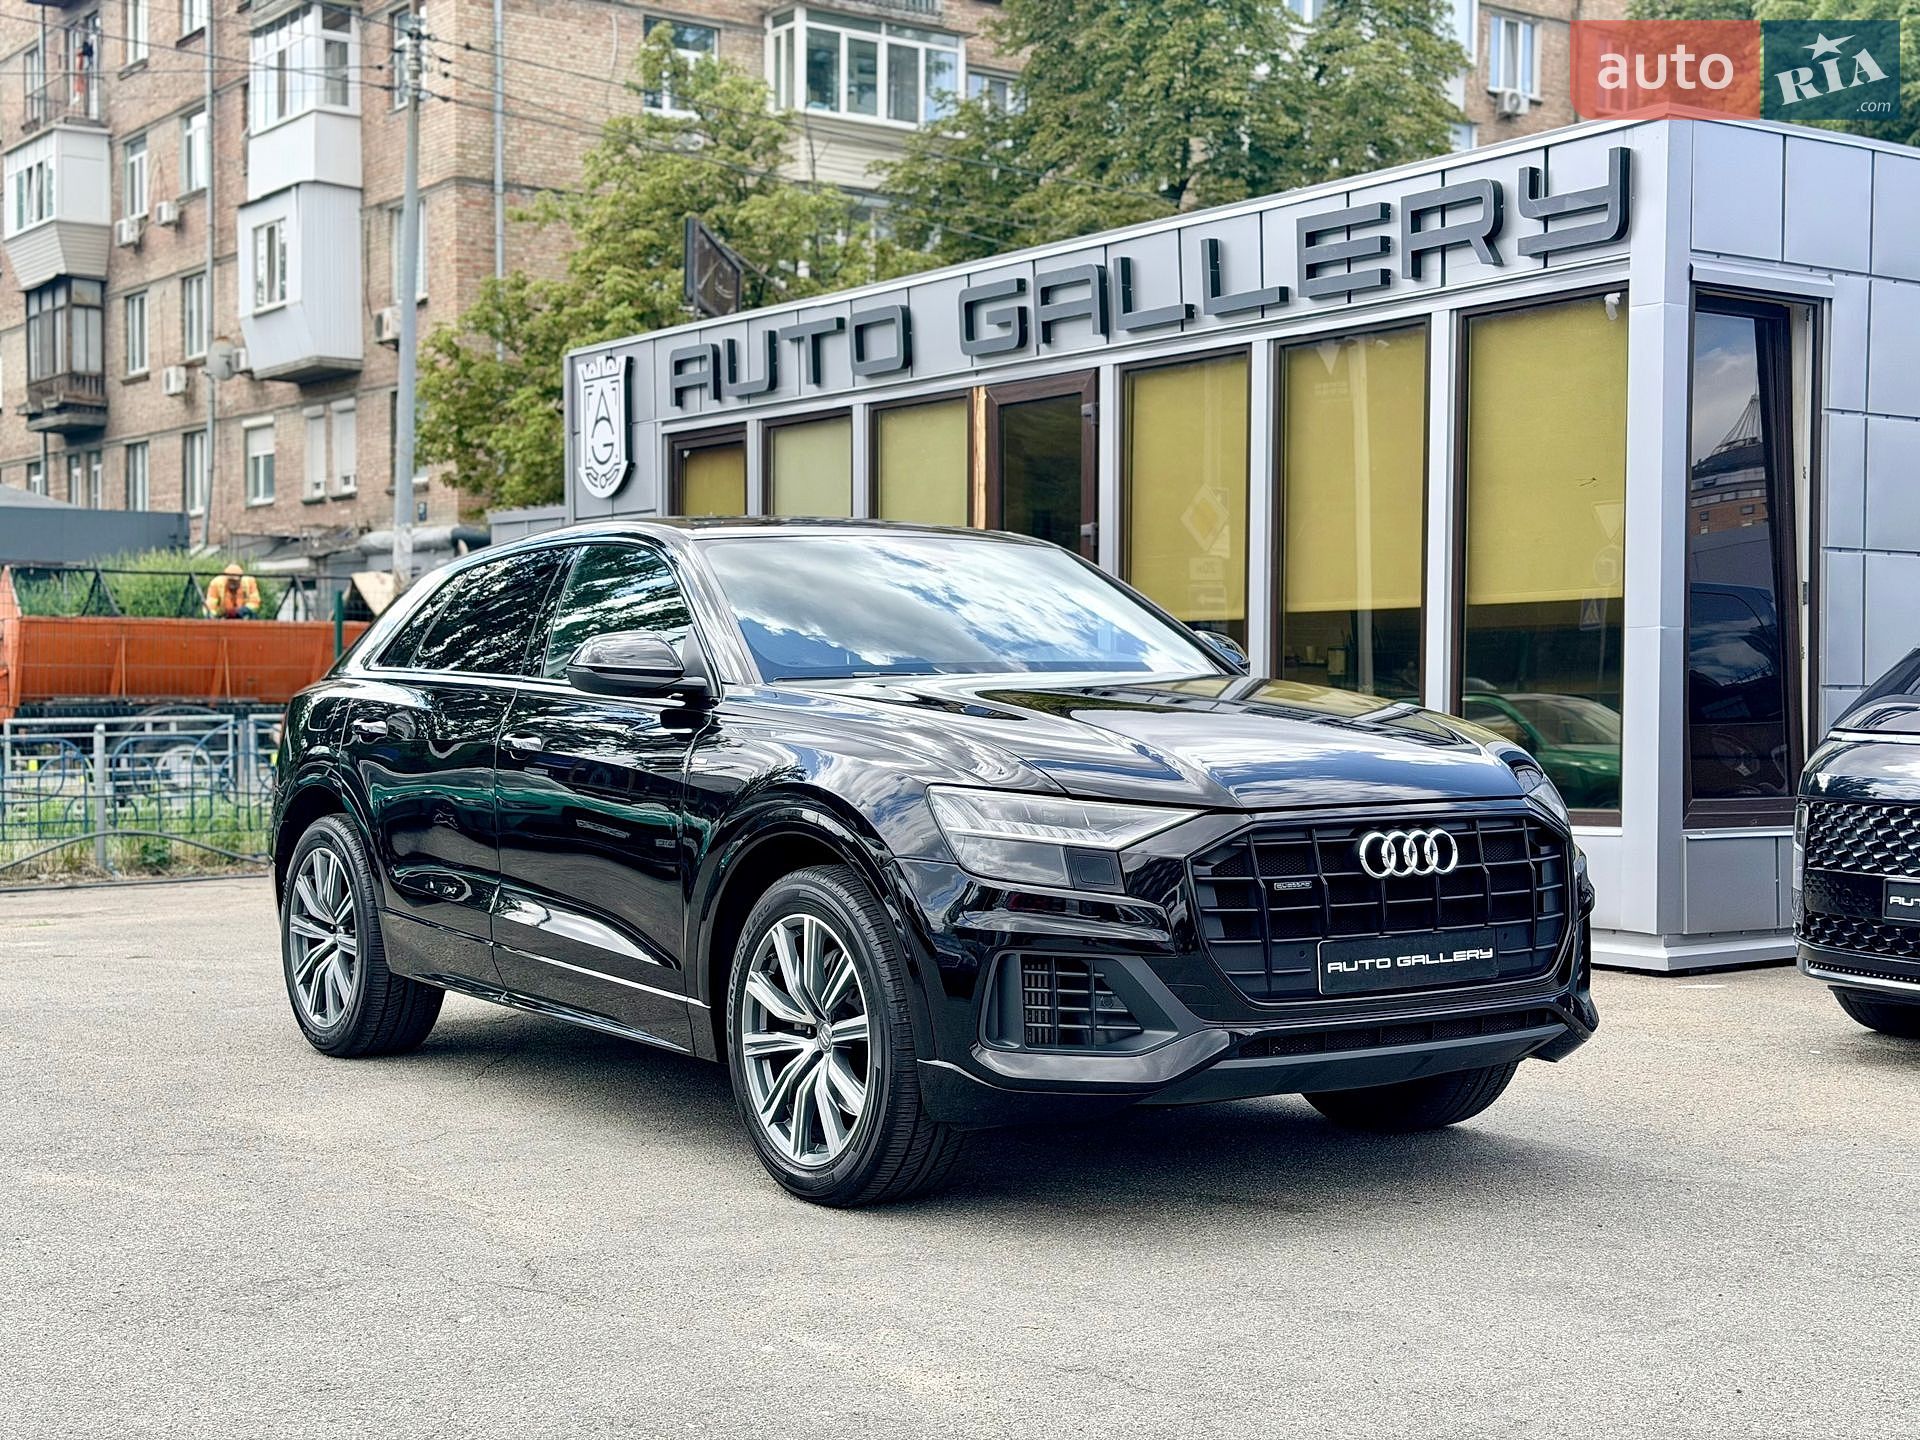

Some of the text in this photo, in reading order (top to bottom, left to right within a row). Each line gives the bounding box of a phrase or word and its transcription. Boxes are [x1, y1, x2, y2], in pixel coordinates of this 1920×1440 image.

[670, 146, 1631, 408] AUTO GALLERY
[1327, 948, 1493, 973] AUTO GALLERY
